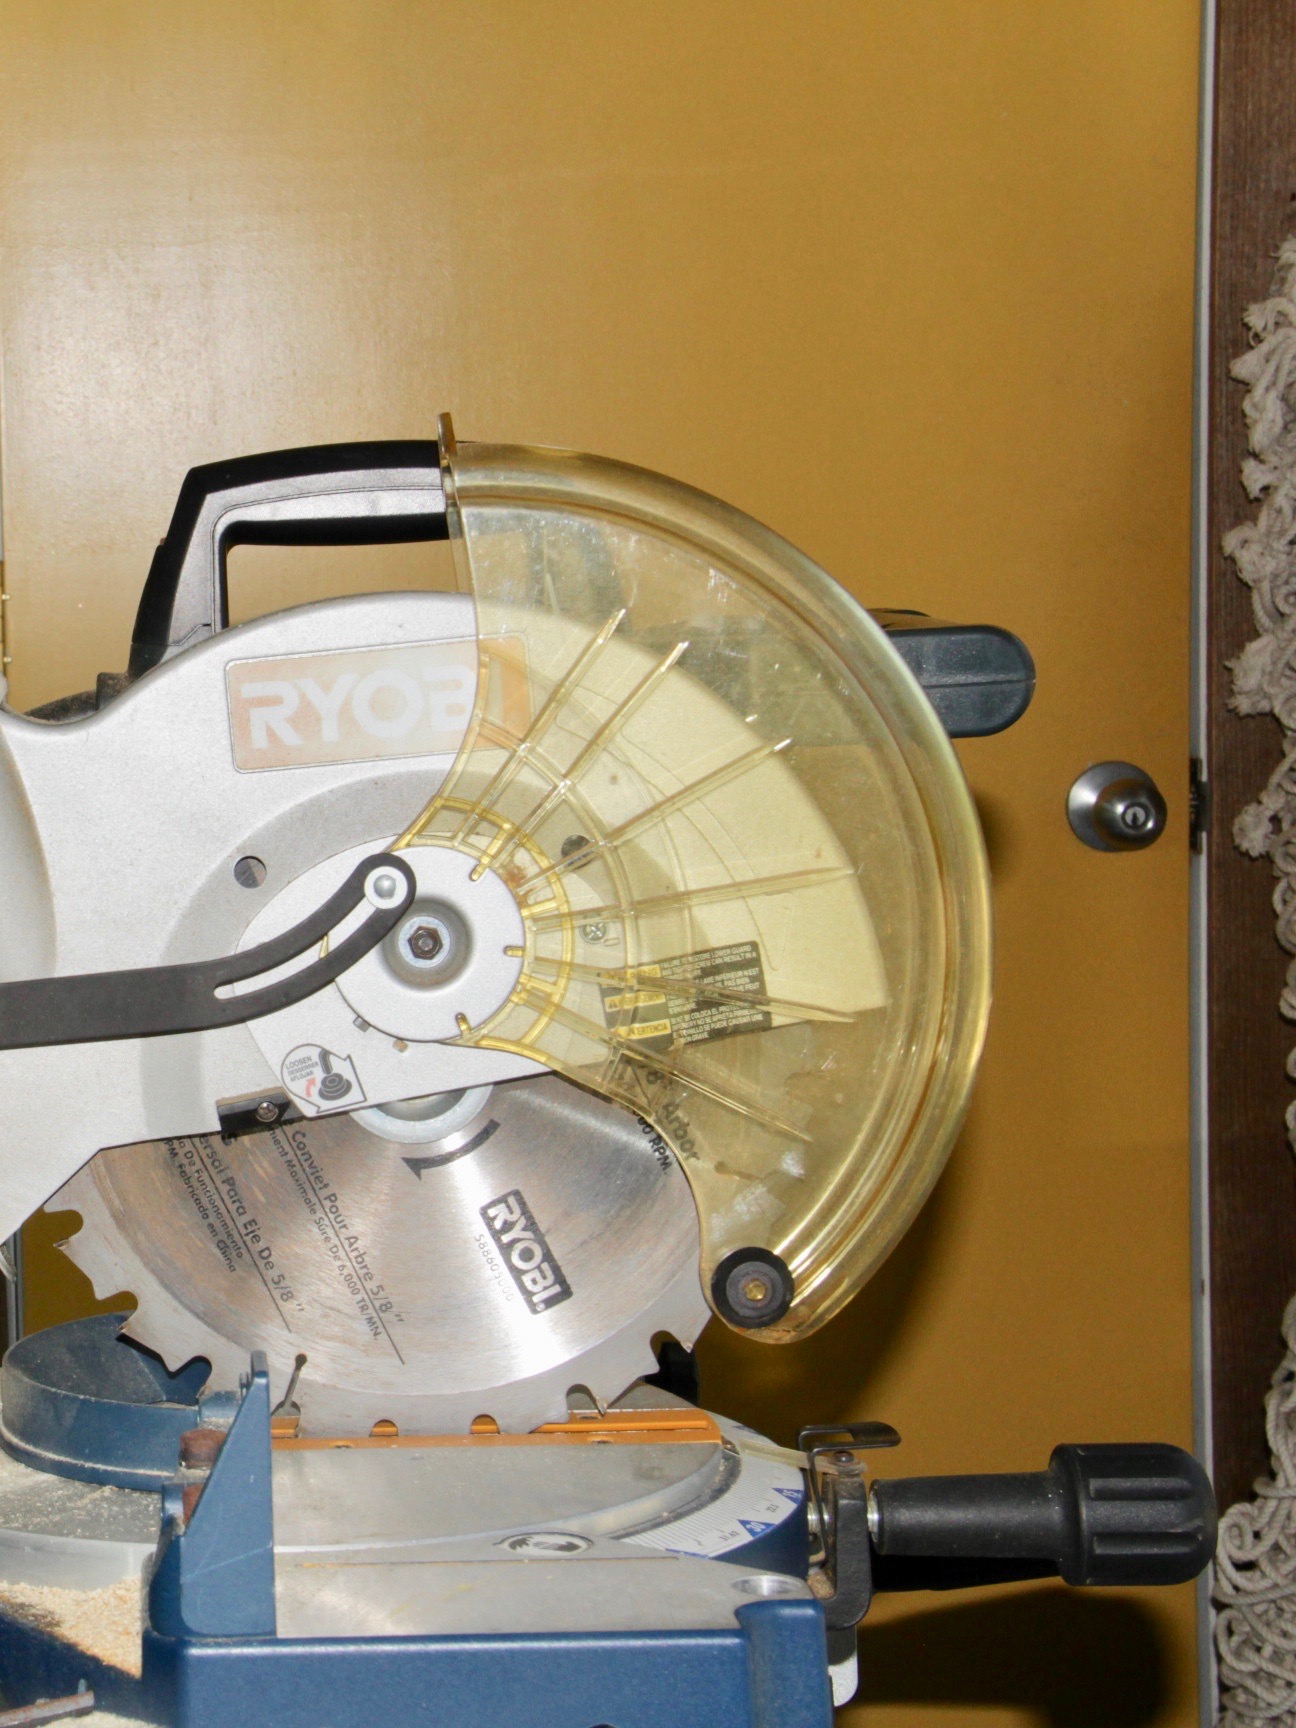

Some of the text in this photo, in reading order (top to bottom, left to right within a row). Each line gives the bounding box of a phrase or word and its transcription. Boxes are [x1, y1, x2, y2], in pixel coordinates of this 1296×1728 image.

[285, 1056, 313, 1070] LOOSEN
[290, 1070, 314, 1082] AFLOJAR
[194, 1168, 243, 1259] Funcionamiento
[221, 1176, 248, 1217] Para
[243, 1218, 262, 1244] Eje
[258, 1246, 275, 1271] De
[291, 1130, 329, 1191] Conviet
[323, 1193, 349, 1231] Pour
[345, 1235, 373, 1282] Arbre
[206, 1222, 218, 1238] en
[216, 1239, 236, 1273] China
[328, 1244, 341, 1261] De
[337, 1264, 361, 1296] 6,000
[487, 1194, 562, 1303] RYOBI
